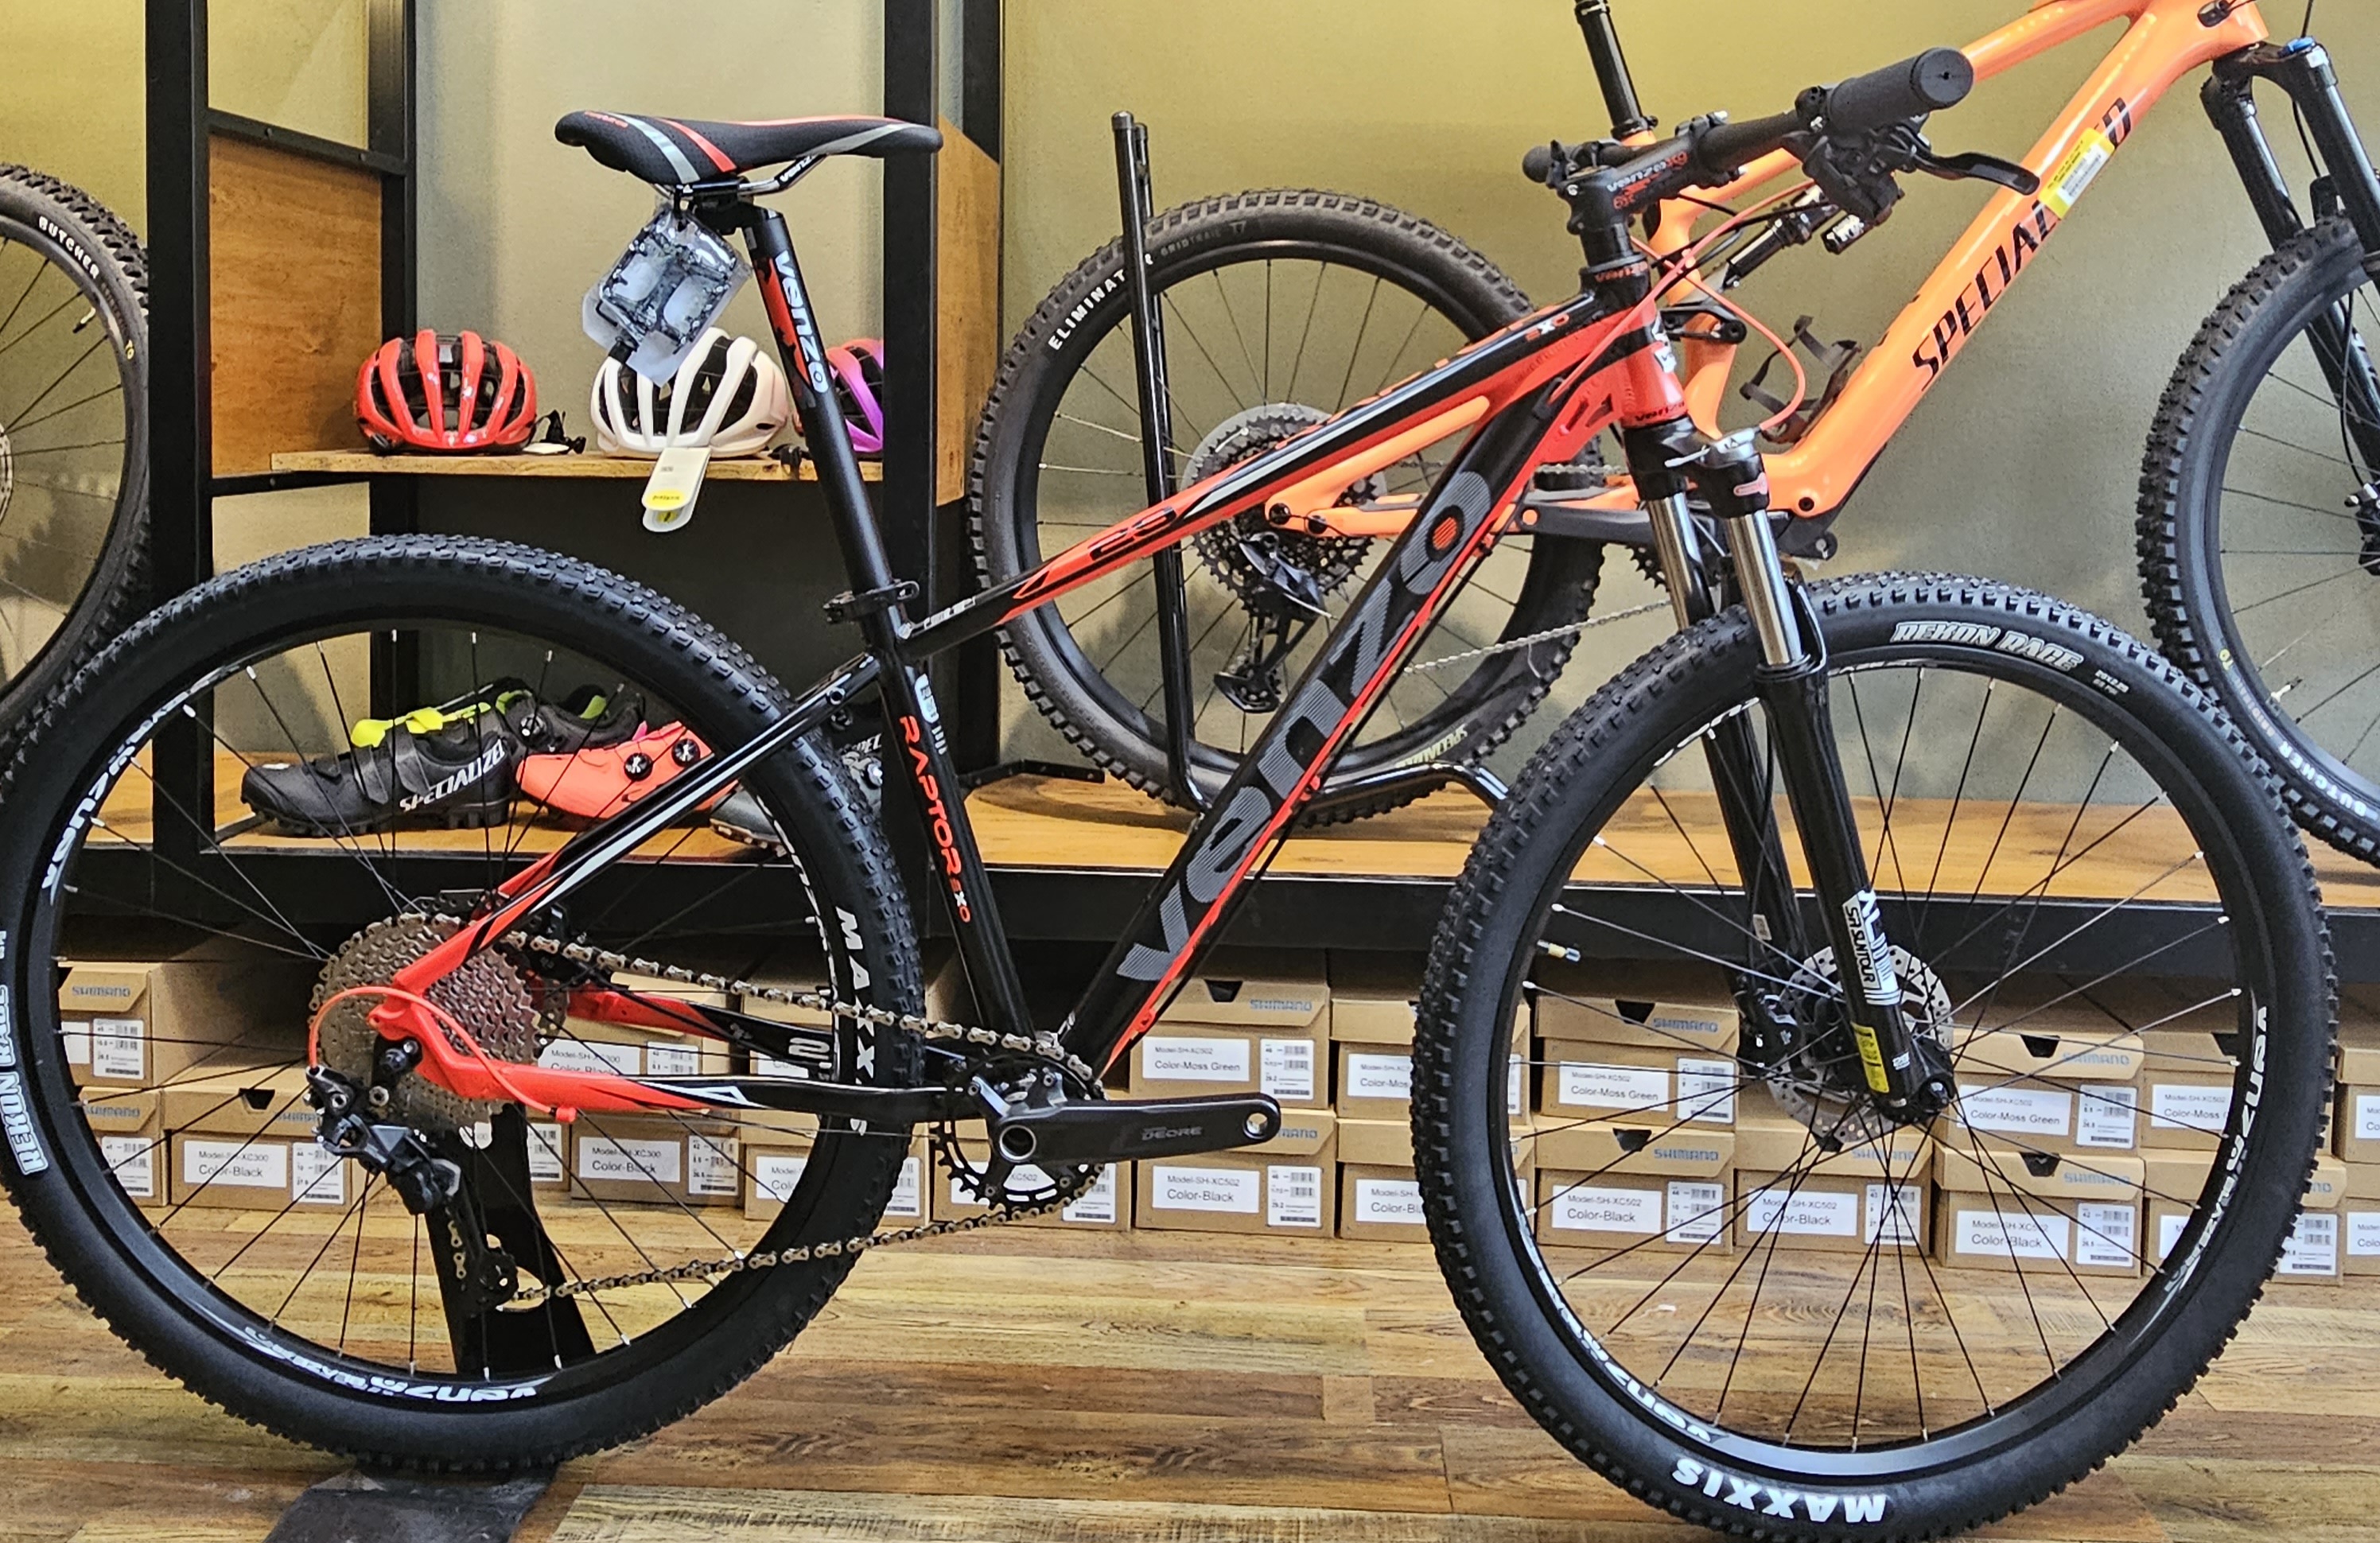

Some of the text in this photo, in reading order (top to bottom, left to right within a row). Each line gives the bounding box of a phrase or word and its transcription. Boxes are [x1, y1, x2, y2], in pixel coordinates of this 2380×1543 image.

[39, 216, 99, 278] BUTCHER
[1048, 253, 1153, 351] ELIMINATR
[775, 251, 829, 393] venzo
[1889, 620, 2084, 671] REKON RACE
[1116, 471, 1491, 981] venzo
[900, 716, 962, 876] RAPTOR
[1250, 998, 1312, 1012] SHIMANO
[1653, 1017, 1719, 1033] SHIMANO
[1155, 1059, 1241, 1071] Color-Moss Green
[2063, 1053, 2130, 1066] SHIMANO
[1571, 1085, 1659, 1102] Color-Moss Green
[1970, 1110, 2060, 1125] Color-Moss Green
[2164, 1108, 2220, 1120] Color-Moss
[1142, 1126, 1202, 1141] DEORE
[1654, 1149, 1720, 1162] SHIMANO
[1167, 1174, 1240, 1187] Model-SH-XC502
[1167, 1188, 1235, 1203] Color-Black
[1567, 1195, 1642, 1207] Model-SH-XC502
[1567, 1208, 1636, 1223] Color-Black
[1672, 1458, 1888, 1524] MAXXIS
